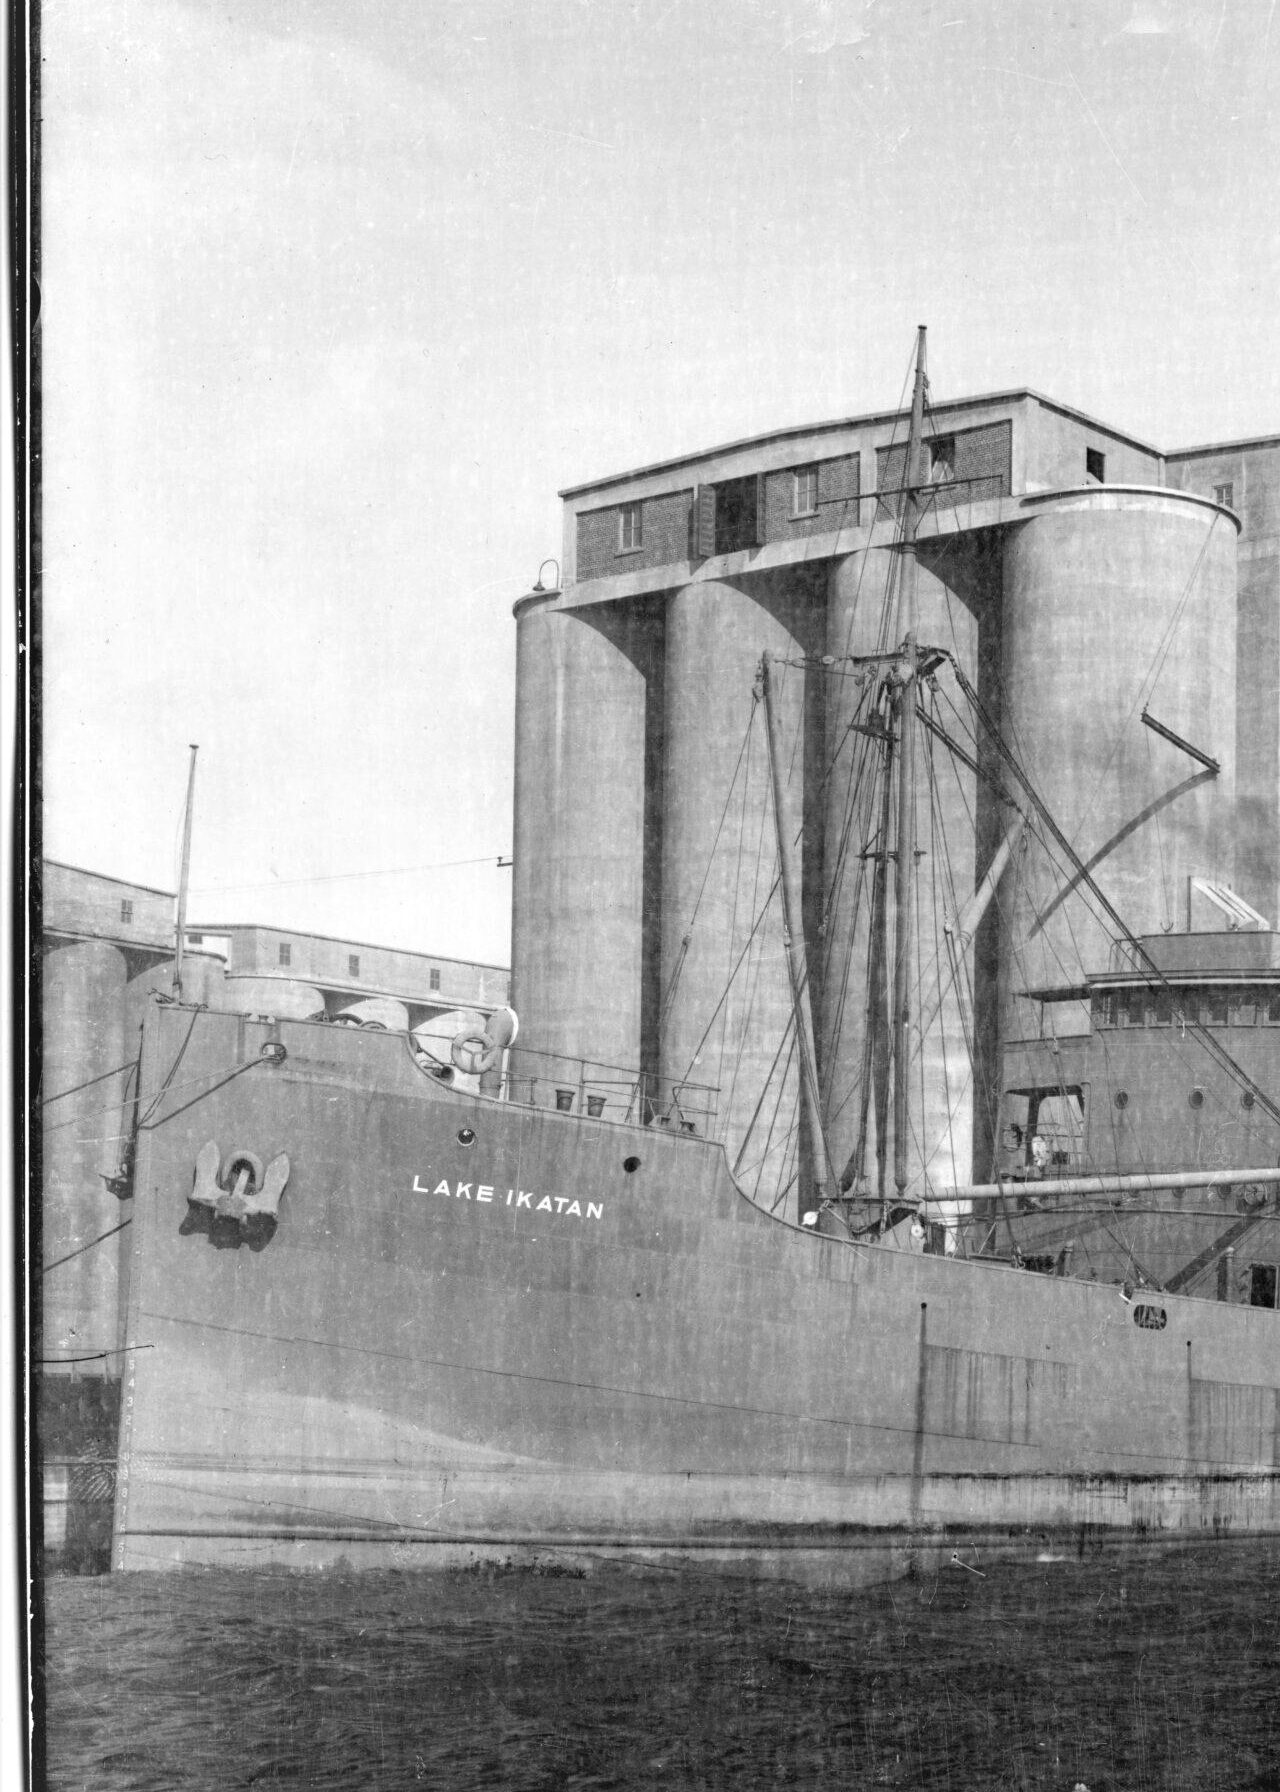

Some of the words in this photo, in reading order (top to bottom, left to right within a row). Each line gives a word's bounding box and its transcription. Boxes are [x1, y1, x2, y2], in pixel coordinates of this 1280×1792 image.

[412, 1175, 495, 1203] LAKE
[505, 1189, 604, 1220] IKATAN
[126, 1396, 134, 1408] 3
[126, 1414, 132, 1426] 2
[121, 1487, 128, 1498] 8
[118, 1541, 125, 1553] 5
